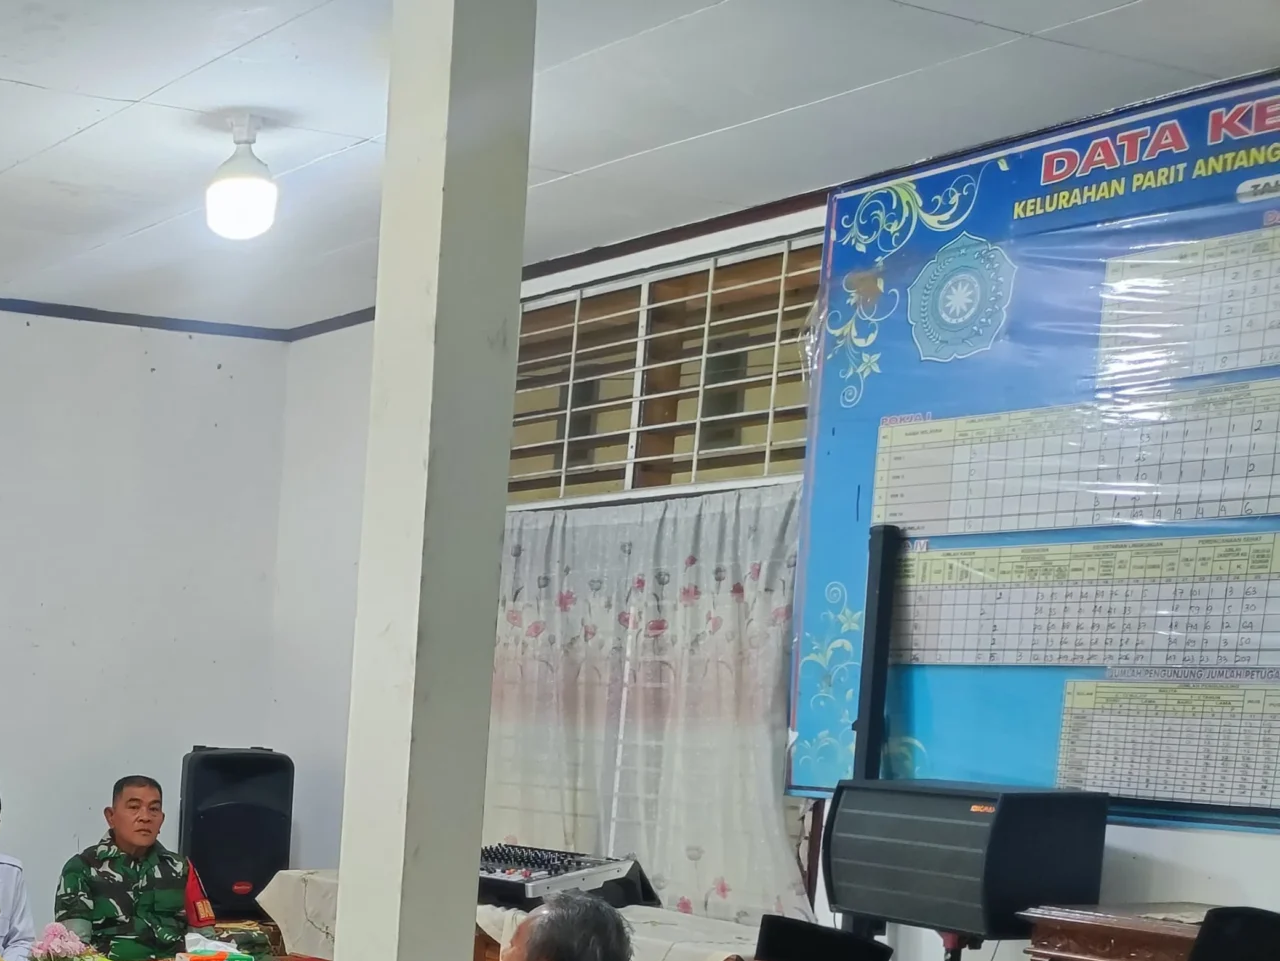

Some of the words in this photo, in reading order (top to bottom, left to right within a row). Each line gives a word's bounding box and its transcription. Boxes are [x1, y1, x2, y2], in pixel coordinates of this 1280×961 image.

[1040, 119, 1190, 186] DATA
[1013, 177, 1125, 220] KELURAHAN
[1132, 163, 1187, 193] PARIT
